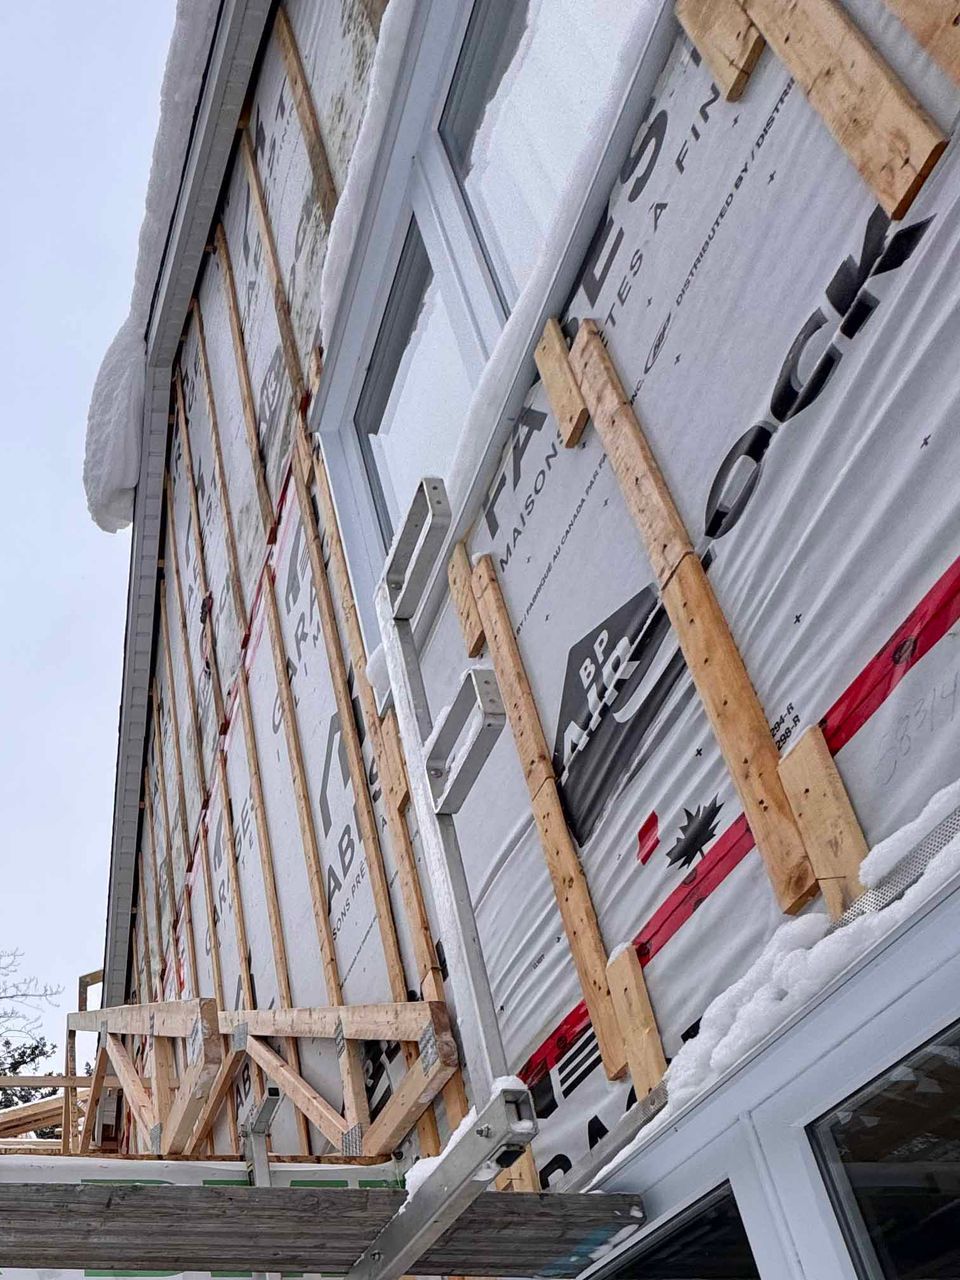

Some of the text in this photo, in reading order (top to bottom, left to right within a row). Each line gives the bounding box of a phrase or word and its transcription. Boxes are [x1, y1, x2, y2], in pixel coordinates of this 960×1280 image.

[675, 193, 734, 307] DISTRIBUTED
[734, 161, 748, 190] BY
[755, 76, 796, 149] DISTRI
[499, 430, 564, 573] MAISON
[675, 82, 721, 175] FIN
[560, 498, 586, 546] CANADA
[578, 628, 609, 690] BP
[769, 702, 795, 738] 294-R
[775, 714, 801, 751] 298-R
